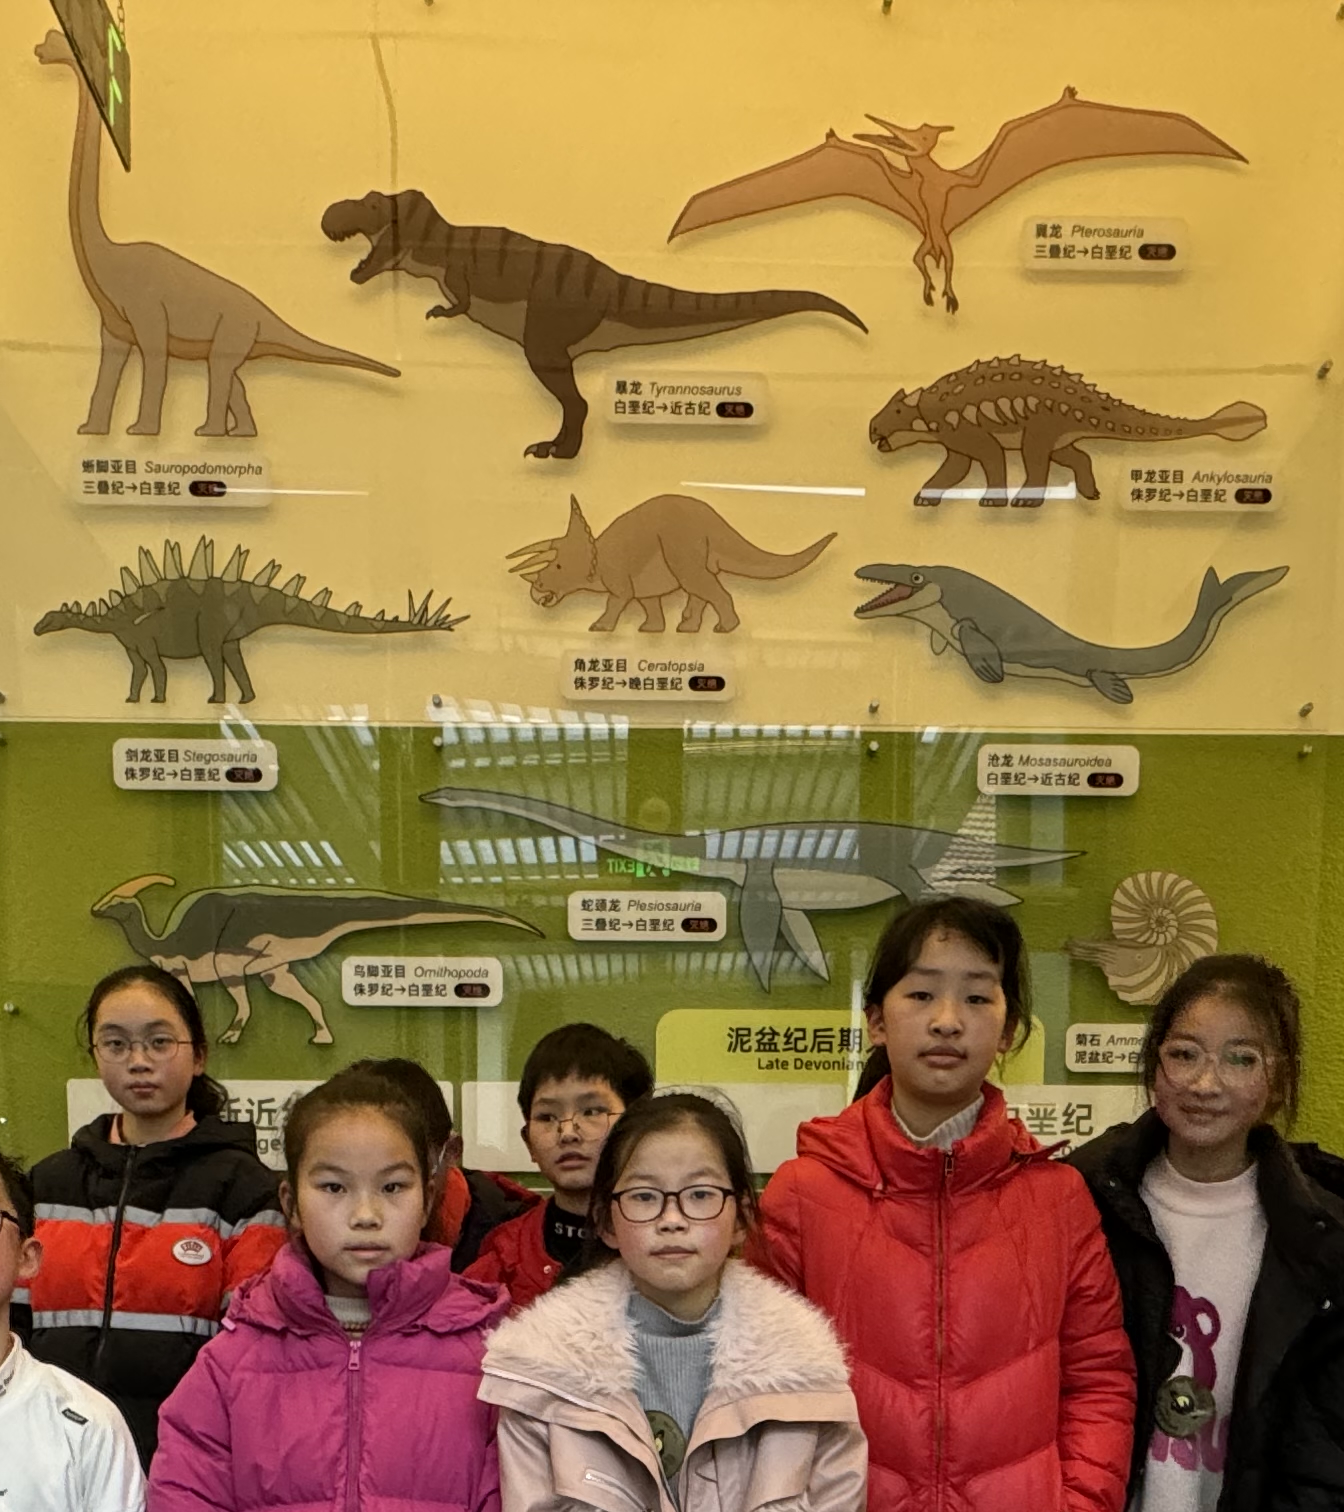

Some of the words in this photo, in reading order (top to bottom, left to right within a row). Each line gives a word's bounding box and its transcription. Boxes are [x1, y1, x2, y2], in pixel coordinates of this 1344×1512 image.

[1071, 225, 1144, 238] Pterosauria
[616, 381, 642, 395] 暴龙
[649, 382, 742, 398] Tyrannosaurus
[144, 461, 262, 477] Sauropodomorpha
[1131, 470, 1184, 484] 甲龙亚目
[1192, 471, 1273, 485] Ankylosauria
[574, 658, 627, 673] 角龙亚目
[638, 660, 704, 674] Ceratopsia
[125, 749, 179, 763] 剑龙亚目
[183, 750, 258, 765] Stegosauria
[1018, 755, 1112, 767] Mosasauroidea
[581, 899, 621, 912] 蛇颈龙
[627, 900, 702, 912] Plesiosauria
[354, 965, 405, 978] 鸟脚亚目
[414, 966, 489, 980] Ornithopoda
[1076, 1034, 1101, 1046] 菊石
[758, 1058, 789, 1070] Late
[794, 1058, 864, 1070] Devonian
